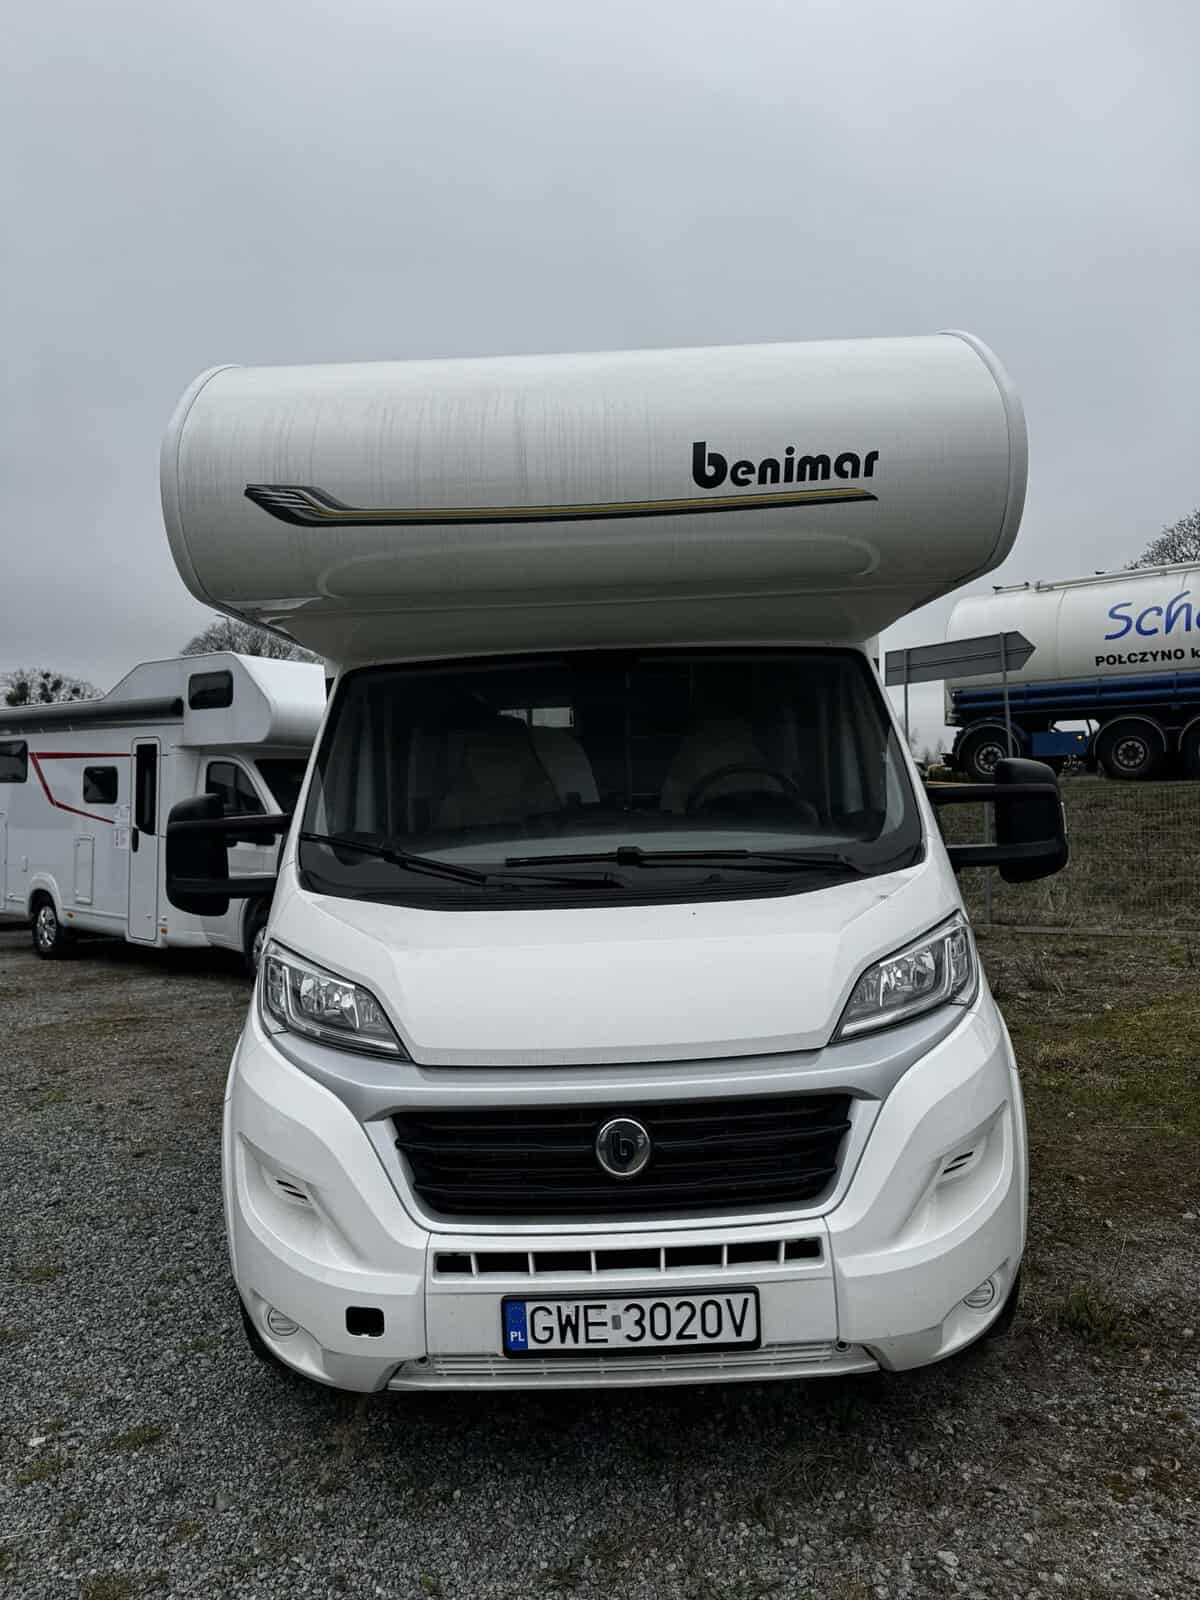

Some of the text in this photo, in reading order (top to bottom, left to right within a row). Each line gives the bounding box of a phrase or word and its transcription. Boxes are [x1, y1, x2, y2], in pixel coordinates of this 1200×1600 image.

[692, 441, 880, 489] benimar
[1104, 590, 1200, 640] Sch
[1095, 648, 1185, 667] POŁCZYNO
[510, 1331, 525, 1342] PL
[530, 1297, 749, 1345] GWE 3020V
